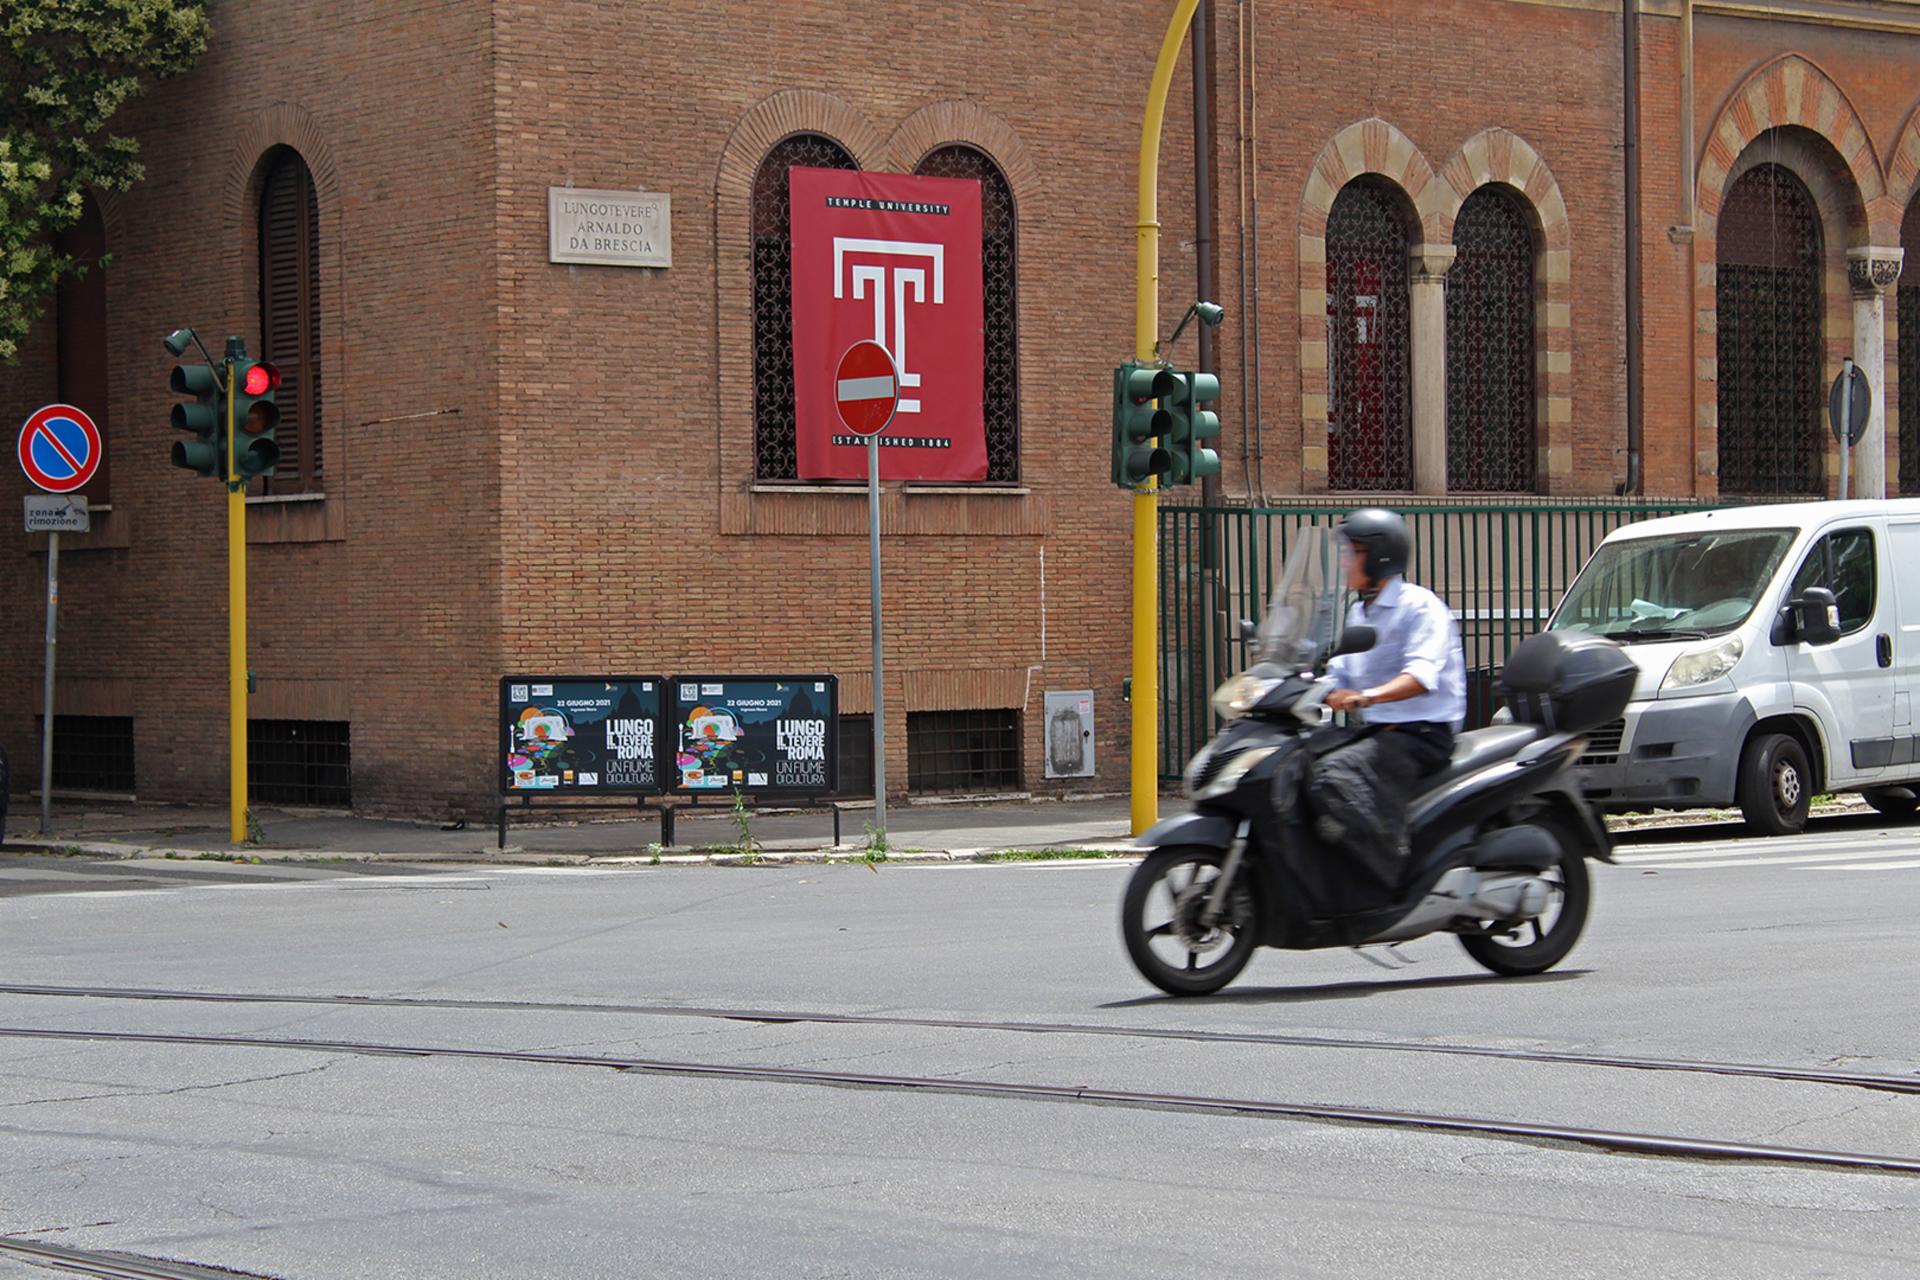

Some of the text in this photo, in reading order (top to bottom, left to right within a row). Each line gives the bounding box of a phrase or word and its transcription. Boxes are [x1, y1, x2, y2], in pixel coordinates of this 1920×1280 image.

[564, 202, 651, 218] LUNGOTEVERE
[827, 197, 949, 214] TEMPLE UNIVERSITY
[577, 221, 643, 235] ARNALDO
[569, 236, 652, 253] DA BRESCIA
[832, 435, 949, 447] ESTABISHED 1884
[29, 517, 78, 526] rimozione
[566, 699, 595, 707] GIUGNO
[736, 699, 766, 707] GIUGNO
[606, 719, 654, 735] LUNGO
[776, 719, 825, 736] LUNGO
[617, 734, 654, 746] TEVERE
[787, 735, 825, 747] TEVERE
[617, 745, 654, 760] ROMA
[787, 746, 825, 760] ROMA
[606, 760, 654, 773] UN FIUME
[776, 760, 825, 773] UN FIUME
[606, 773, 654, 784] DI CULTURA
[776, 774, 785, 785] DI
[785, 774, 825, 785] CULTURA
